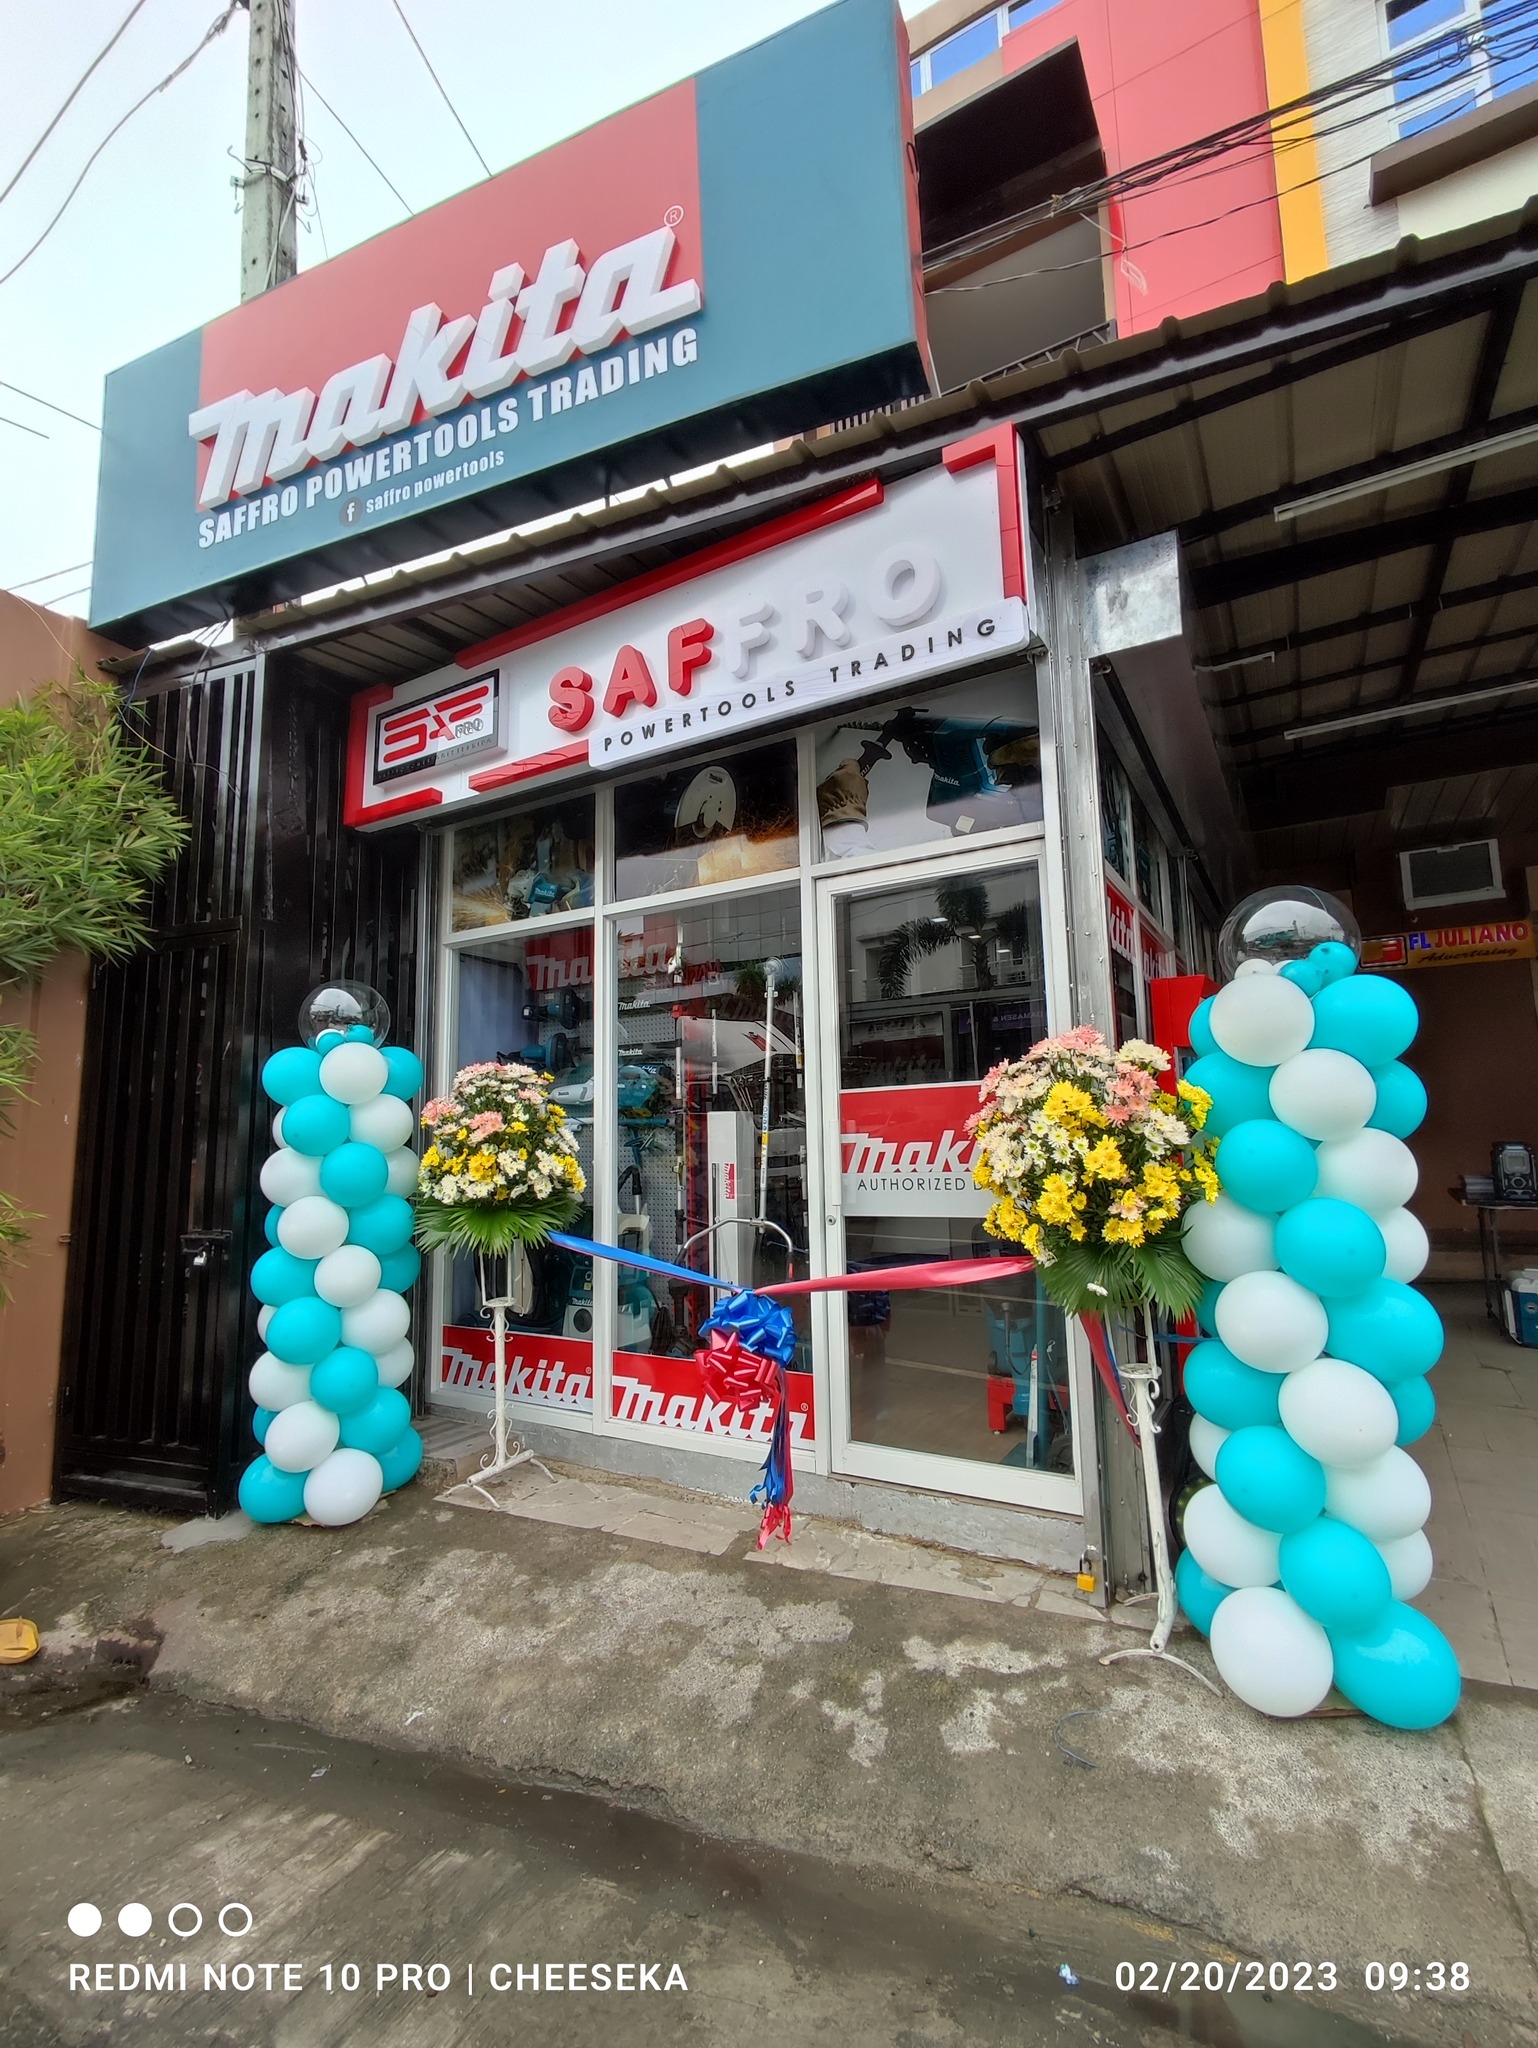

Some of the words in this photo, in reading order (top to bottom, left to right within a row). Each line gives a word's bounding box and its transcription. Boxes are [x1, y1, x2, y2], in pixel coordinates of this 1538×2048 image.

[198, 484, 298, 549] SAFFRO
[305, 398, 519, 511] POWERTOOLS
[527, 328, 699, 421] TRADING
[366, 486, 412, 514] saffro
[413, 449, 506, 498] powertools
[548, 544, 941, 732] SAFFRO
[604, 680, 798, 748] POWERTOOLS
[829, 618, 997, 684] TRADING
[1408, 931, 1431, 951] FL
[1434, 922, 1529, 949] JULIANO
[1418, 948, 1518, 964] Advertising
[857, 1177, 966, 1191] AUTHORIZED
